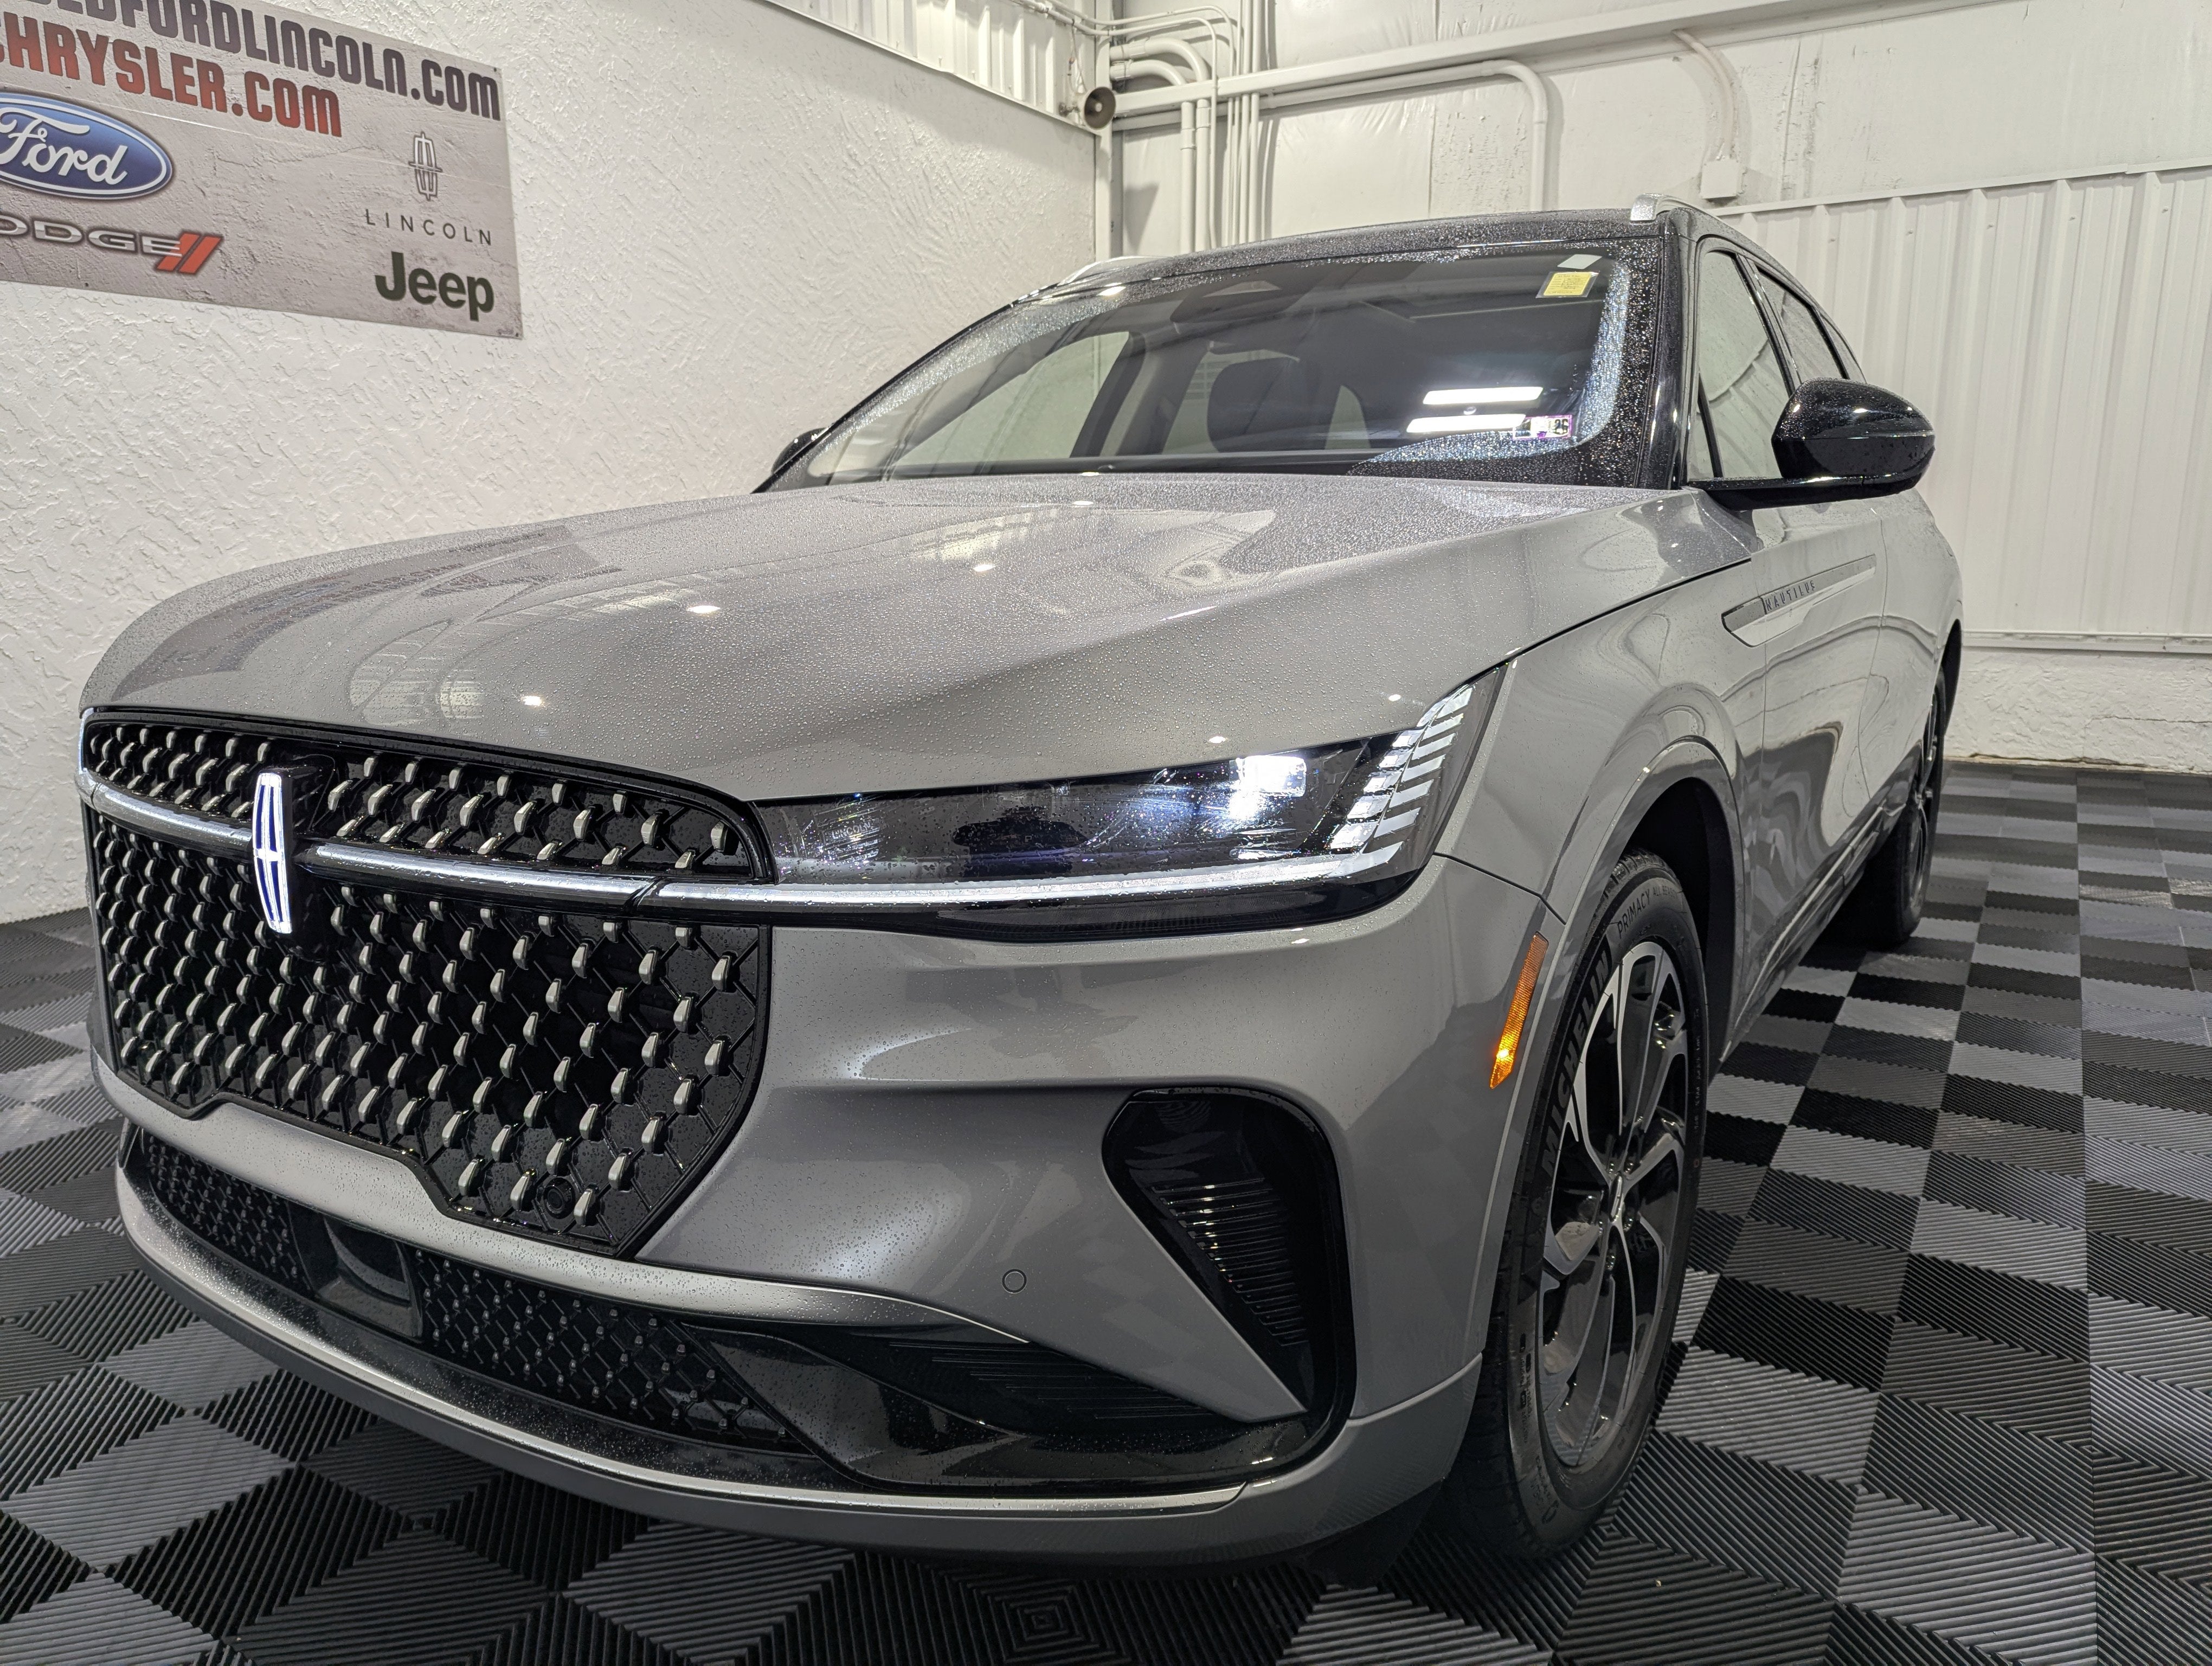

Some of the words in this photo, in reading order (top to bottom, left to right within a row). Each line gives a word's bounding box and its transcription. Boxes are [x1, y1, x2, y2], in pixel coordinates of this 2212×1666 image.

[0, 11, 342, 138] HRYSLER.COM
[0, 108, 128, 185] Ford
[365, 208, 491, 246] LINCOLN
[374, 251, 494, 322] Jeep
[1765, 580, 1815, 611] NAUTILUS
[1617, 889, 1650, 939] PRIMACY
[1540, 950, 1611, 1178] MICHELIN
